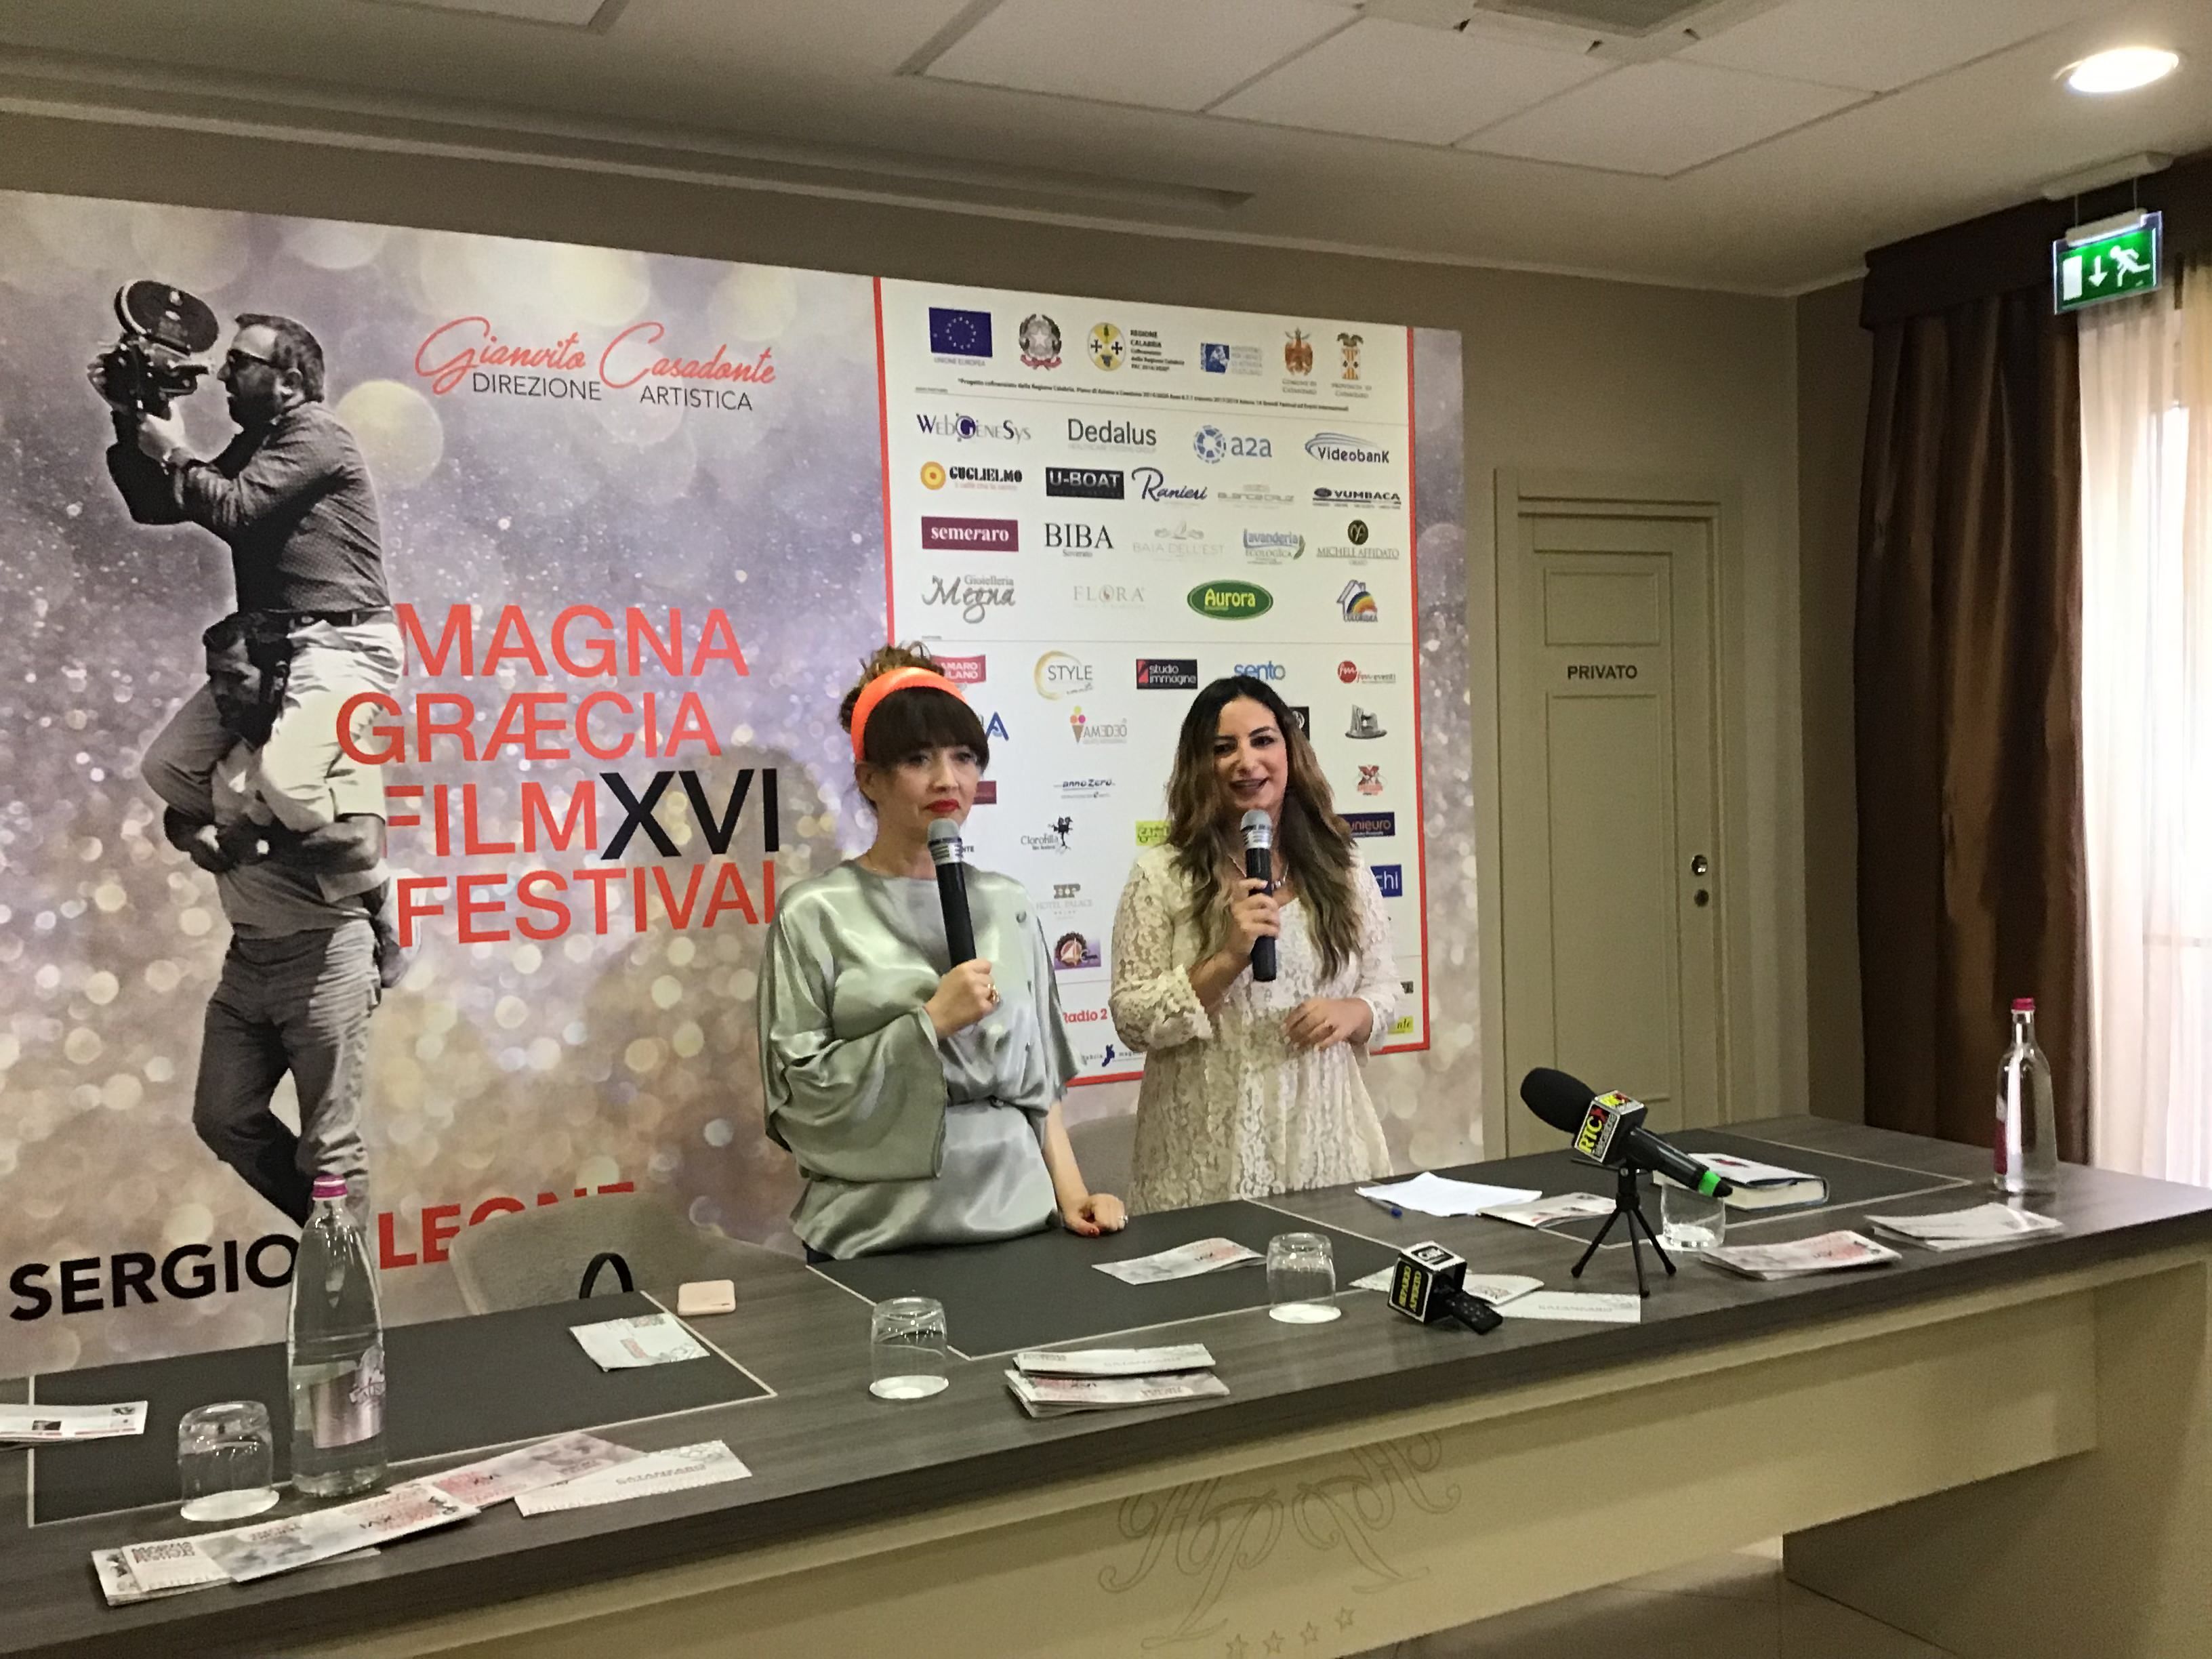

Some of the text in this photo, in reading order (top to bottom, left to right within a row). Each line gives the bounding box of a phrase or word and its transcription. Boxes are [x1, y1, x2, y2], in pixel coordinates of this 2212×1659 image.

[415, 316, 777, 396] Gianvito Casadonte
[472, 372, 753, 412] DIREZIONE ARTISTICA
[1068, 417, 1157, 446] Dedalus
[1231, 436, 1273, 458] a2a
[1050, 470, 1120, 488] U-BOAT
[1334, 490, 1401, 501] VUMBACA
[930, 525, 1009, 542] semeraro
[1044, 523, 1114, 549] BIBA
[1204, 588, 1256, 609] Aurora
[394, 602, 750, 678] MAGNA
[1048, 665, 1093, 680] STYLE
[1568, 665, 1638, 680] PRIVATO
[384, 767, 780, 861] FILM XVI
[9, 1233, 297, 1323] SERGIO
